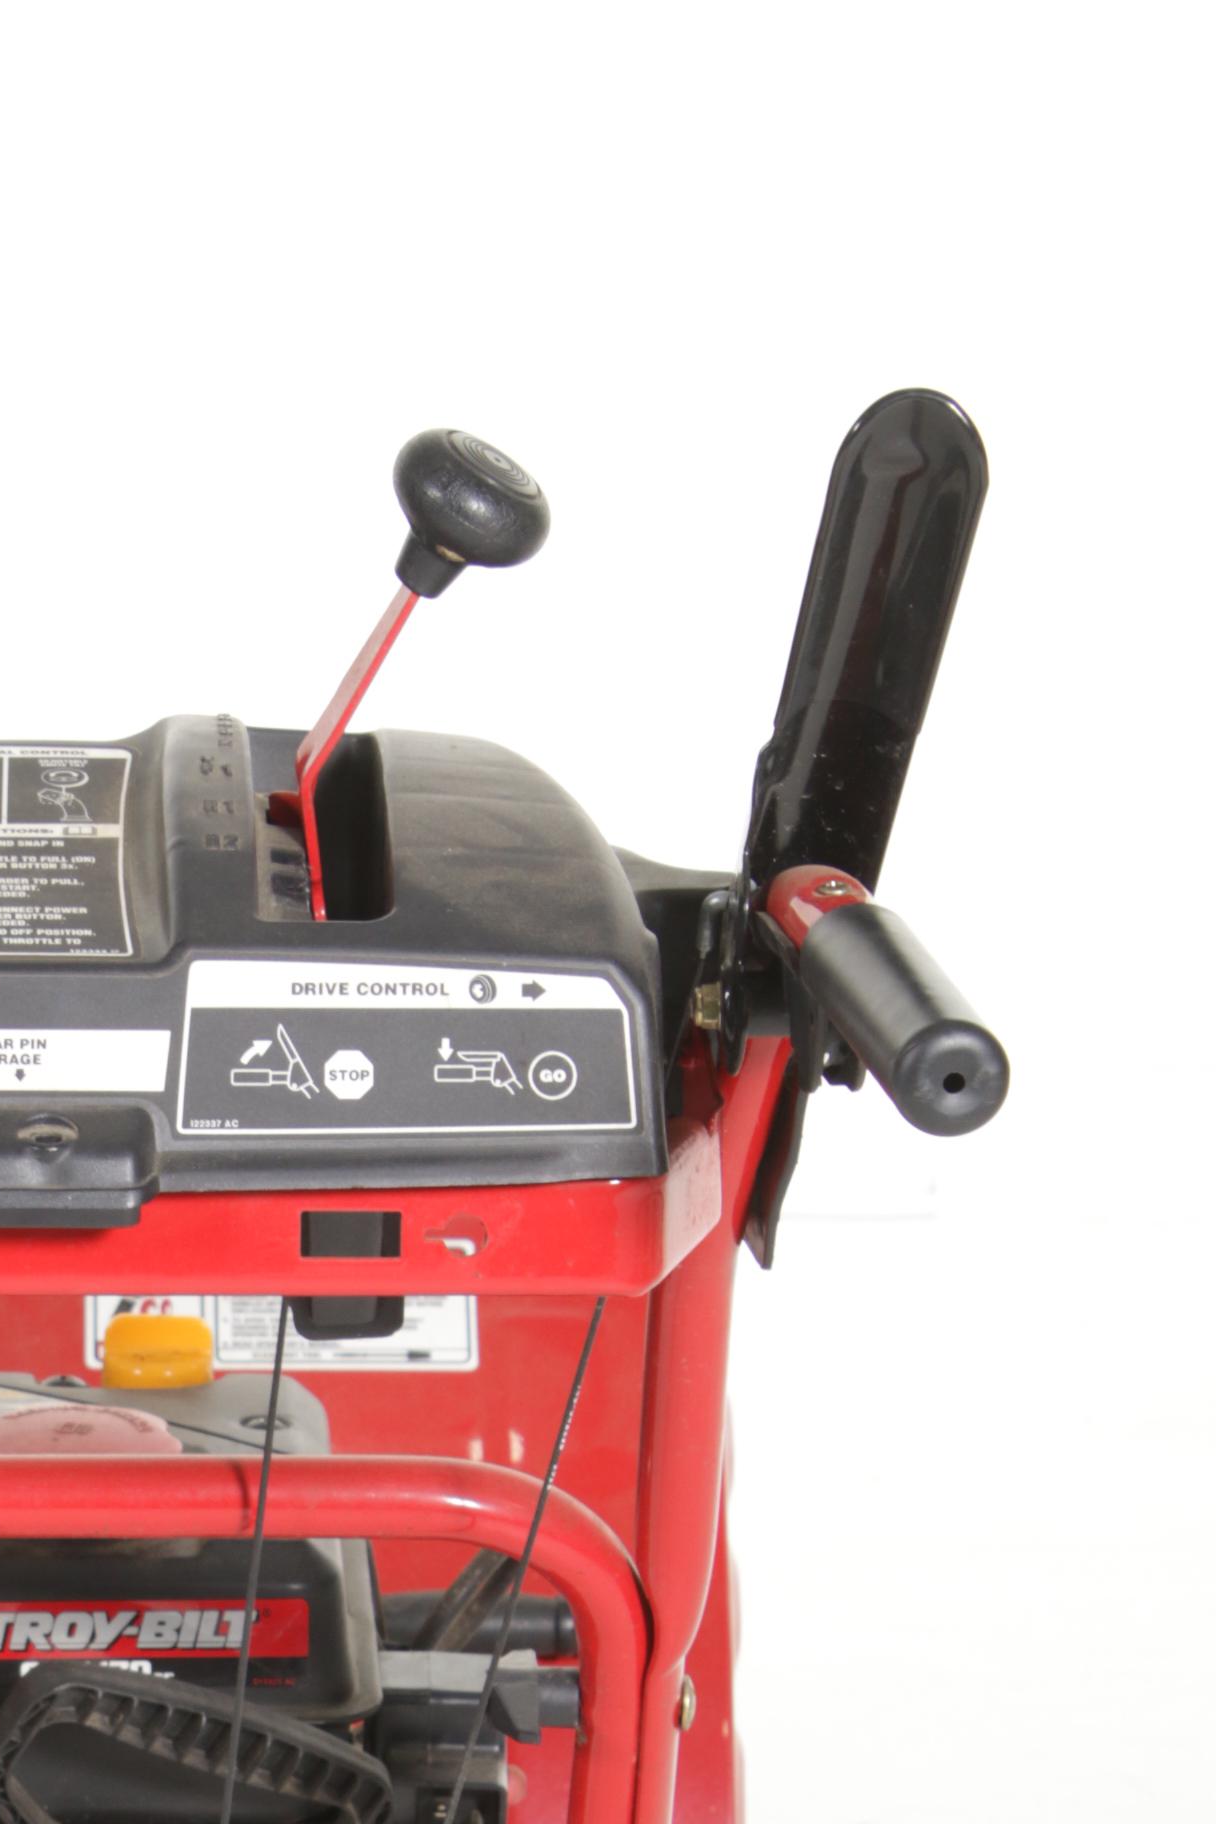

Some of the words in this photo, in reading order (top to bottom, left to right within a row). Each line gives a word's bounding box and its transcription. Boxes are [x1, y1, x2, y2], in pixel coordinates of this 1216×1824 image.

[291, 982, 349, 996] DRIVE
[357, 982, 450, 996] CONTROL
[19, 1038, 47, 1050] PIN
[329, 1069, 370, 1081] STOP
[539, 1069, 566, 1082] GO
[225, 1119, 239, 1128] AC
